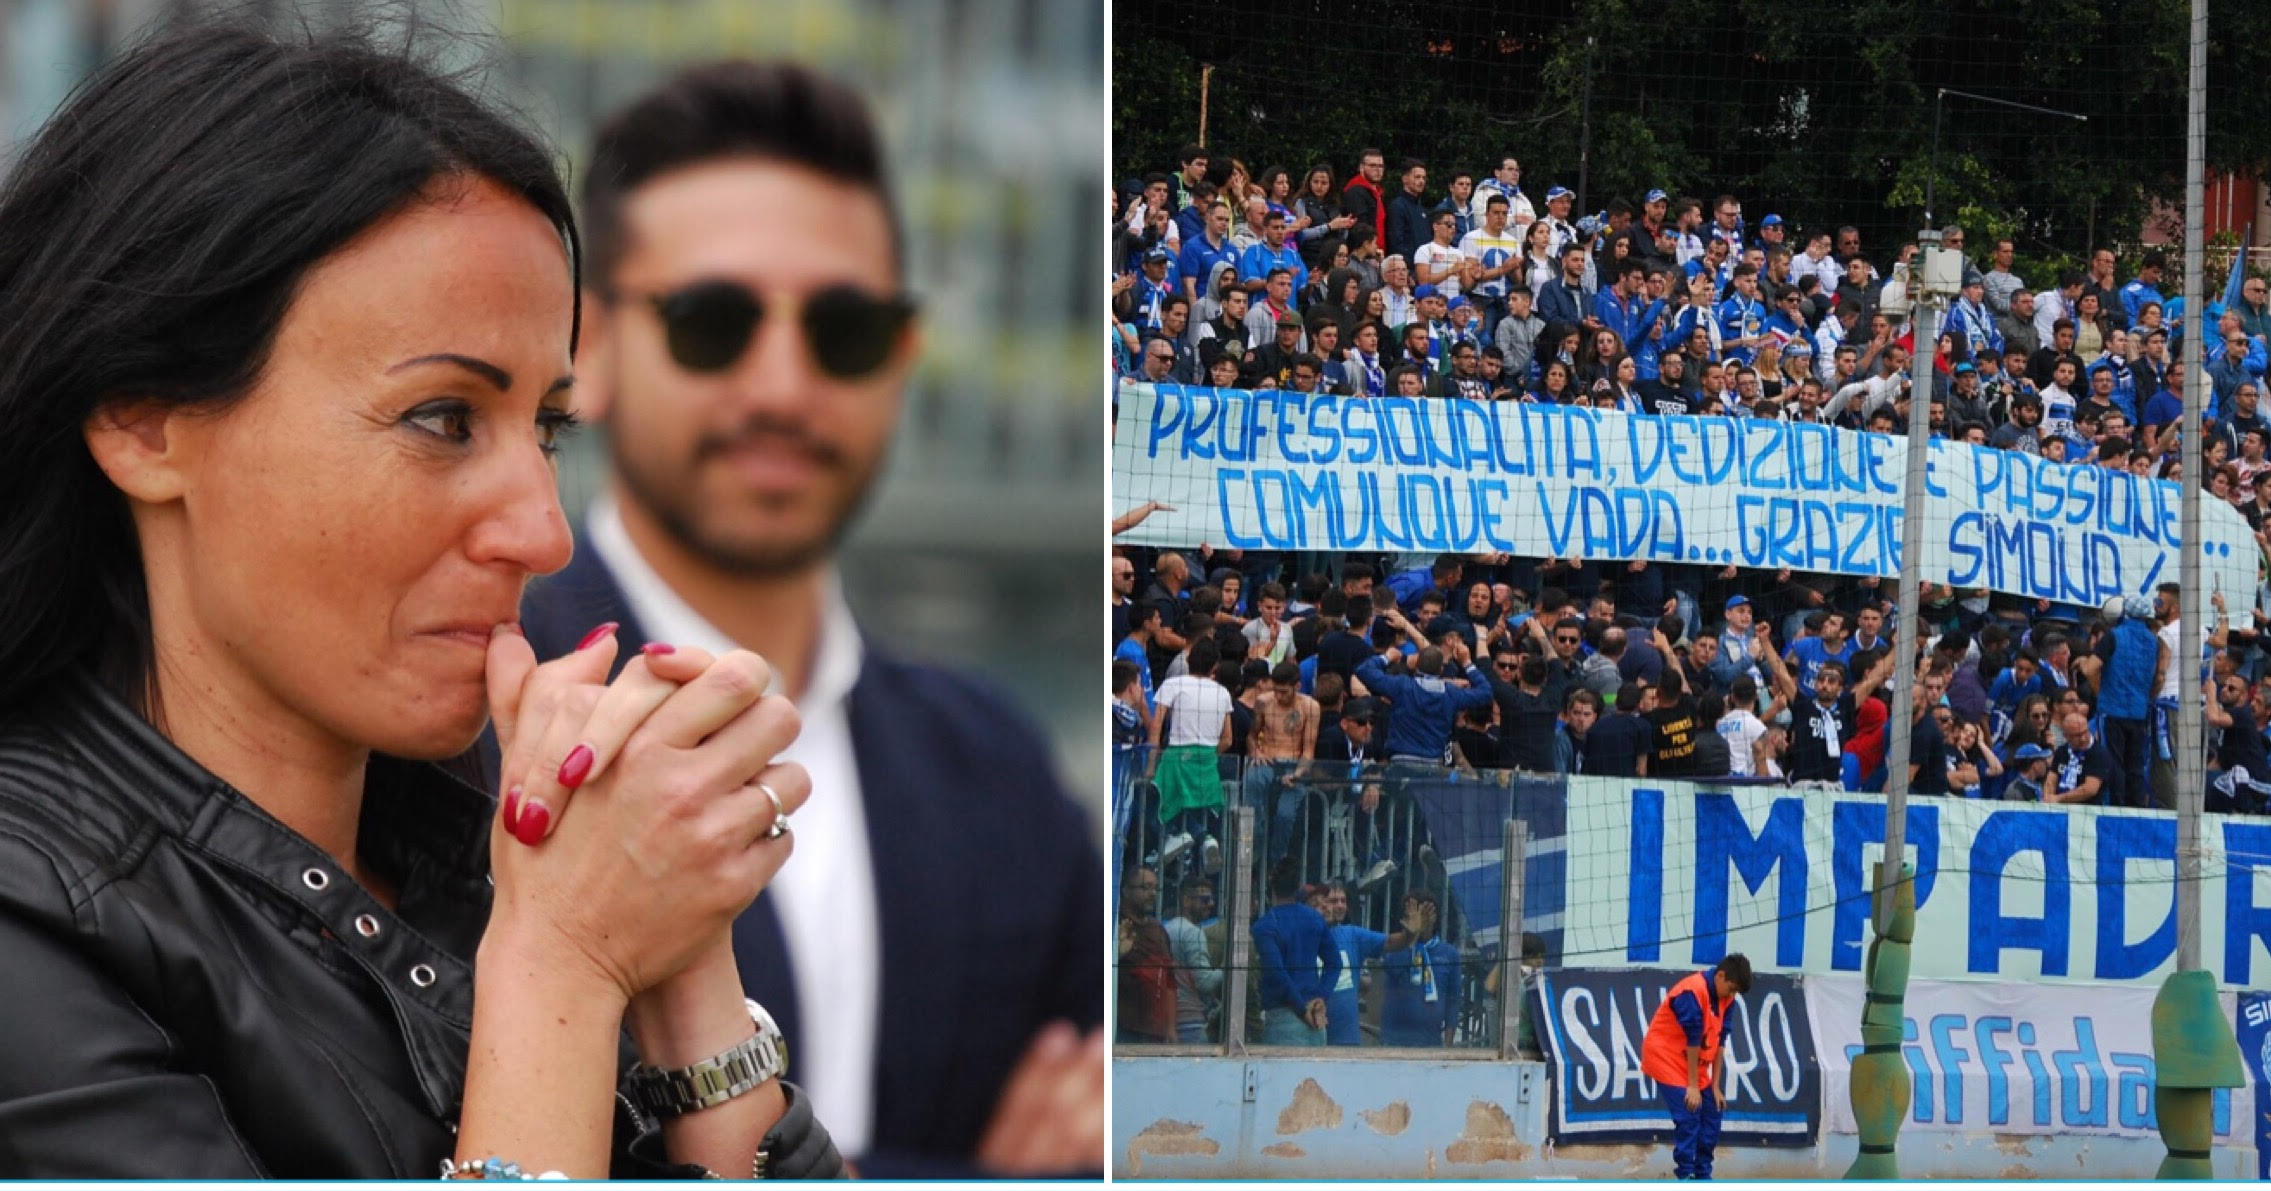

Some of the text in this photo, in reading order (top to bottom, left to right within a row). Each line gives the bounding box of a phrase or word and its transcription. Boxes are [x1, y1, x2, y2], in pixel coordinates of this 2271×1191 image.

[1627, 413, 1898, 496] DEDIZIONE
[1217, 467, 1514, 551] COMUNQUE
[1948, 511, 2123, 607] SIMONA
